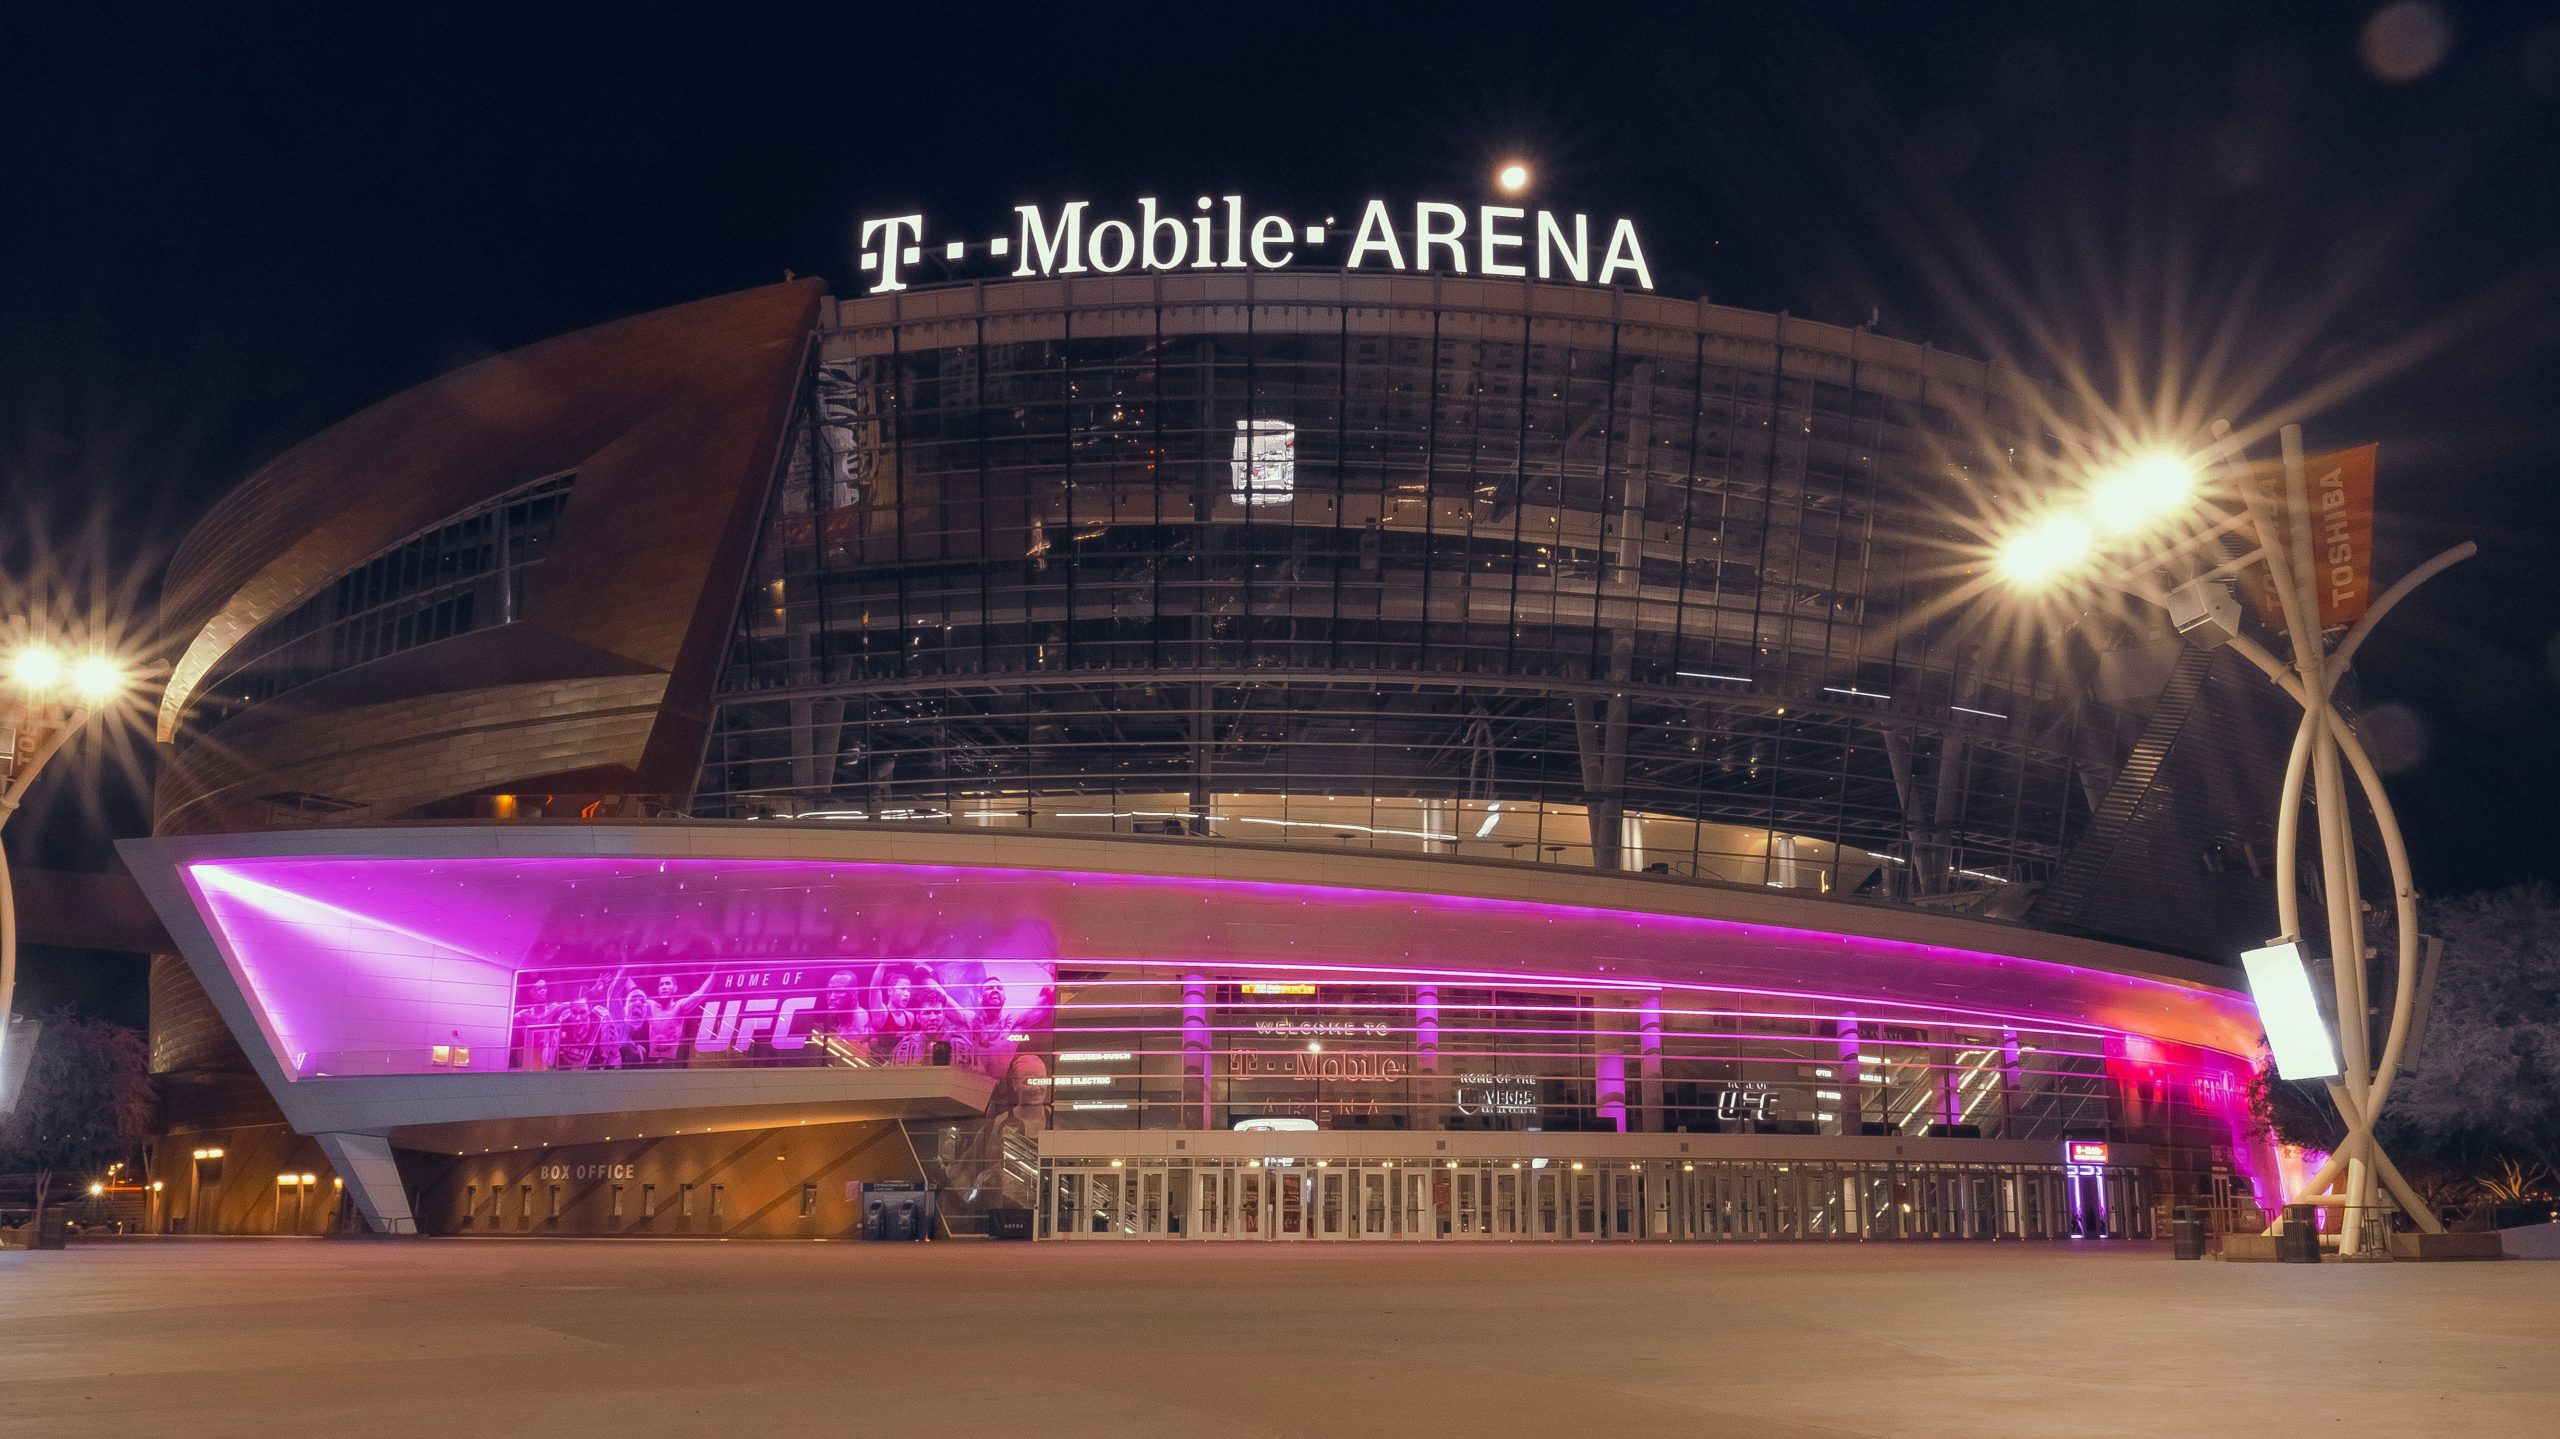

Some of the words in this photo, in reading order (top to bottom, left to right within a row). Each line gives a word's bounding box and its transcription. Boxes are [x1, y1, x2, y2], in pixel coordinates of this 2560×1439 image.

[1347, 200, 1654, 290] ARENA
[2320, 467, 2355, 608] TOSHIBA
[725, 973, 770, 988] HOME
[782, 971, 803, 985] OF
[695, 997, 817, 1052] UFC
[1256, 1021, 1354, 1036] WELCOME
[1363, 1021, 1389, 1036] TO
[1461, 1073, 1493, 1084] HOME
[1718, 1091, 1780, 1120] UFC
[540, 1165, 570, 1180] BOX
[576, 1164, 635, 1179] OFFICE
